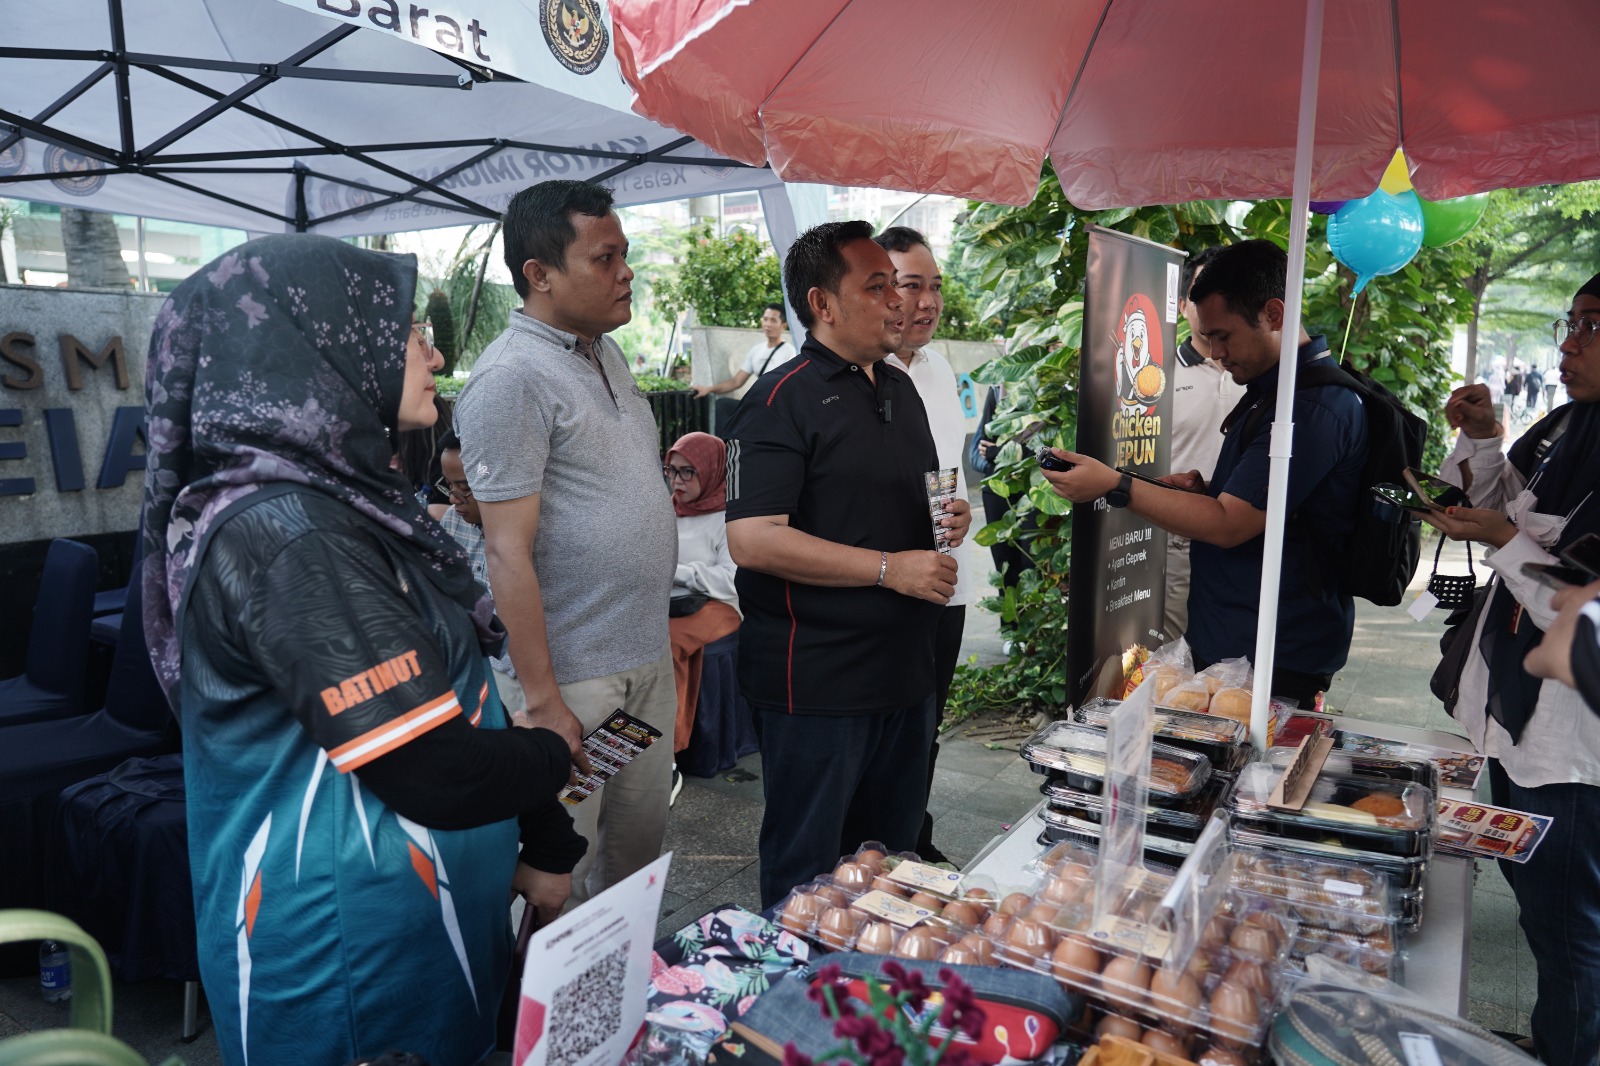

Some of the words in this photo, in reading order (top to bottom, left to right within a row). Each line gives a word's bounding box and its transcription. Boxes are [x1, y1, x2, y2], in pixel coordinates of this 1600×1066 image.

[573, 61, 598, 73] INDONESIA
[1112, 409, 1161, 440] Chicken
[1114, 438, 1156, 468] JEPUN
[1109, 534, 1125, 551] MENU
[1125, 529, 1144, 546] BARU
[1111, 557, 1125, 572] Ayam
[1125, 548, 1147, 565] Geprek
[1110, 592, 1133, 612] Breakfast
[1133, 588, 1151, 602] Menu
